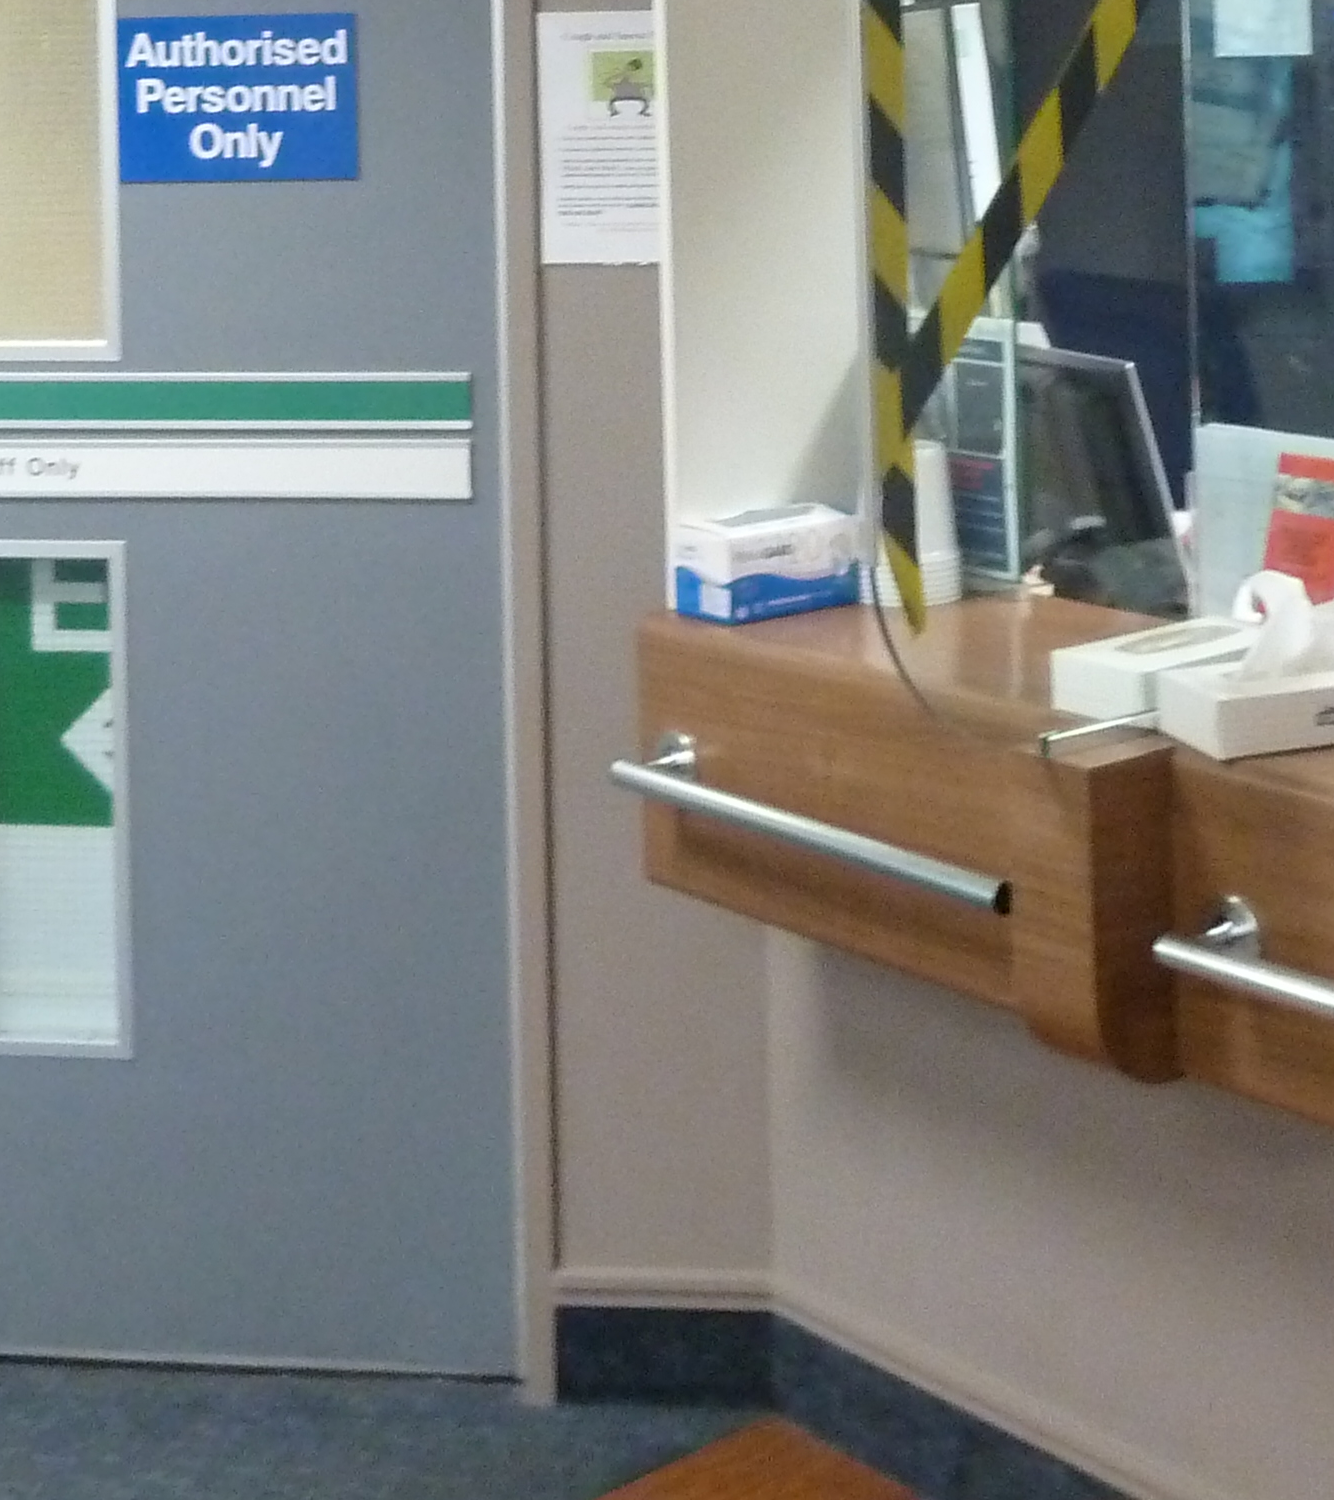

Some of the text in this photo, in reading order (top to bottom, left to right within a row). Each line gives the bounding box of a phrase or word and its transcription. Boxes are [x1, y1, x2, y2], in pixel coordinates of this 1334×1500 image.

[125, 28, 348, 68] Authorised
[136, 75, 337, 114] Personnel
[189, 122, 284, 168] Only
[27, 457, 82, 481] Only
